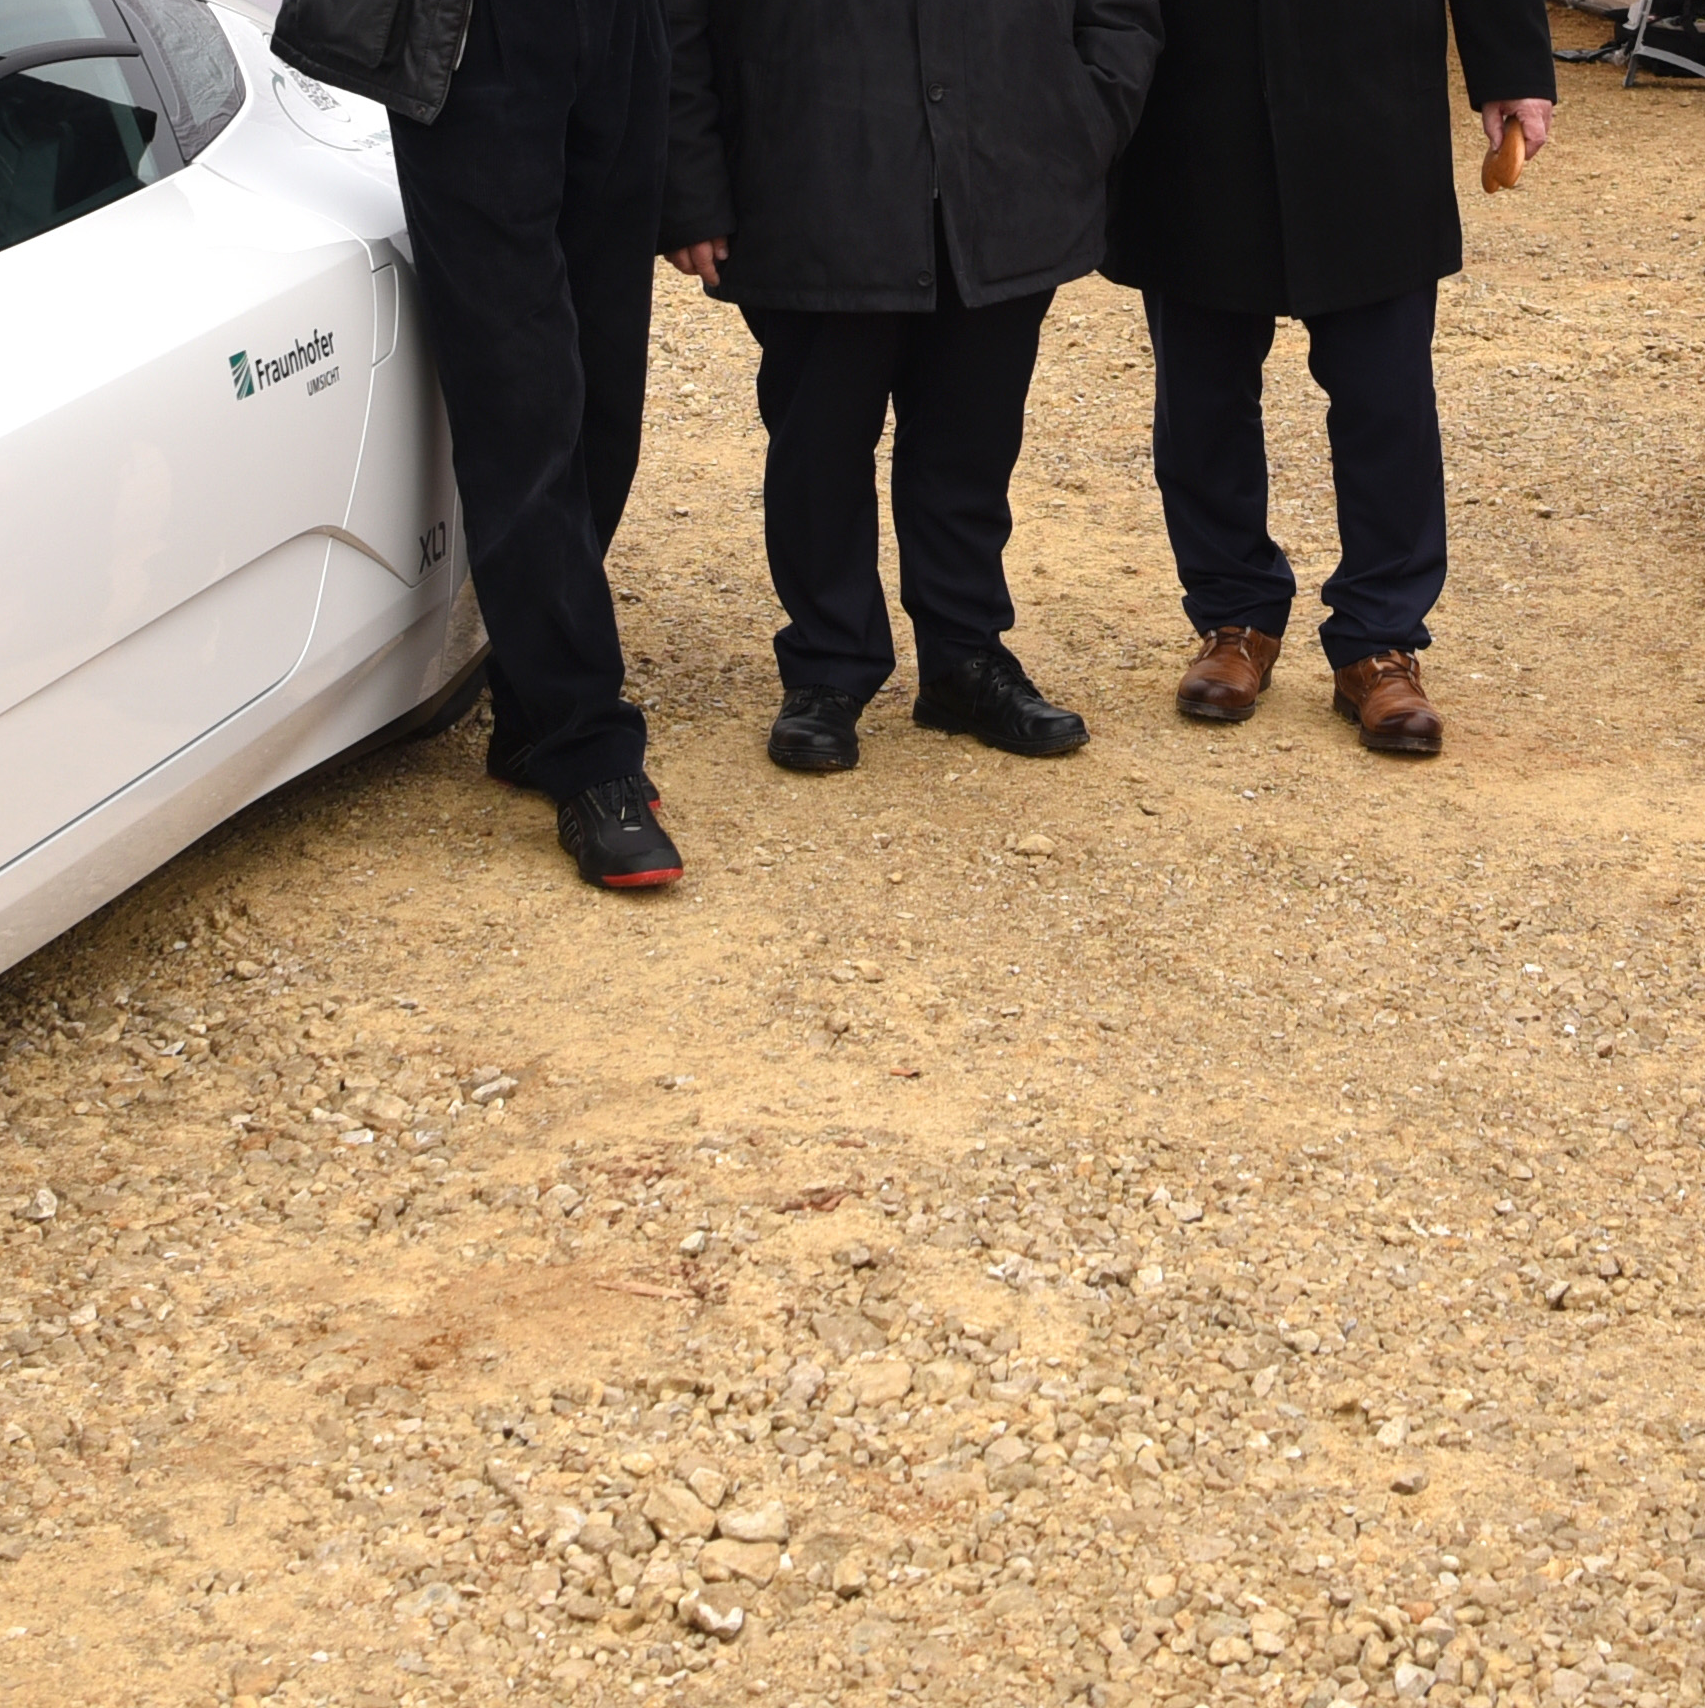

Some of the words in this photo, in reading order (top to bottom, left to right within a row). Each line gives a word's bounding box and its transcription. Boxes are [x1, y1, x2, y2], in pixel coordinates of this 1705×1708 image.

[254, 327, 335, 391] Fraunhofer
[305, 365, 341, 397] UMSICHT
[418, 520, 447, 576] XL1
